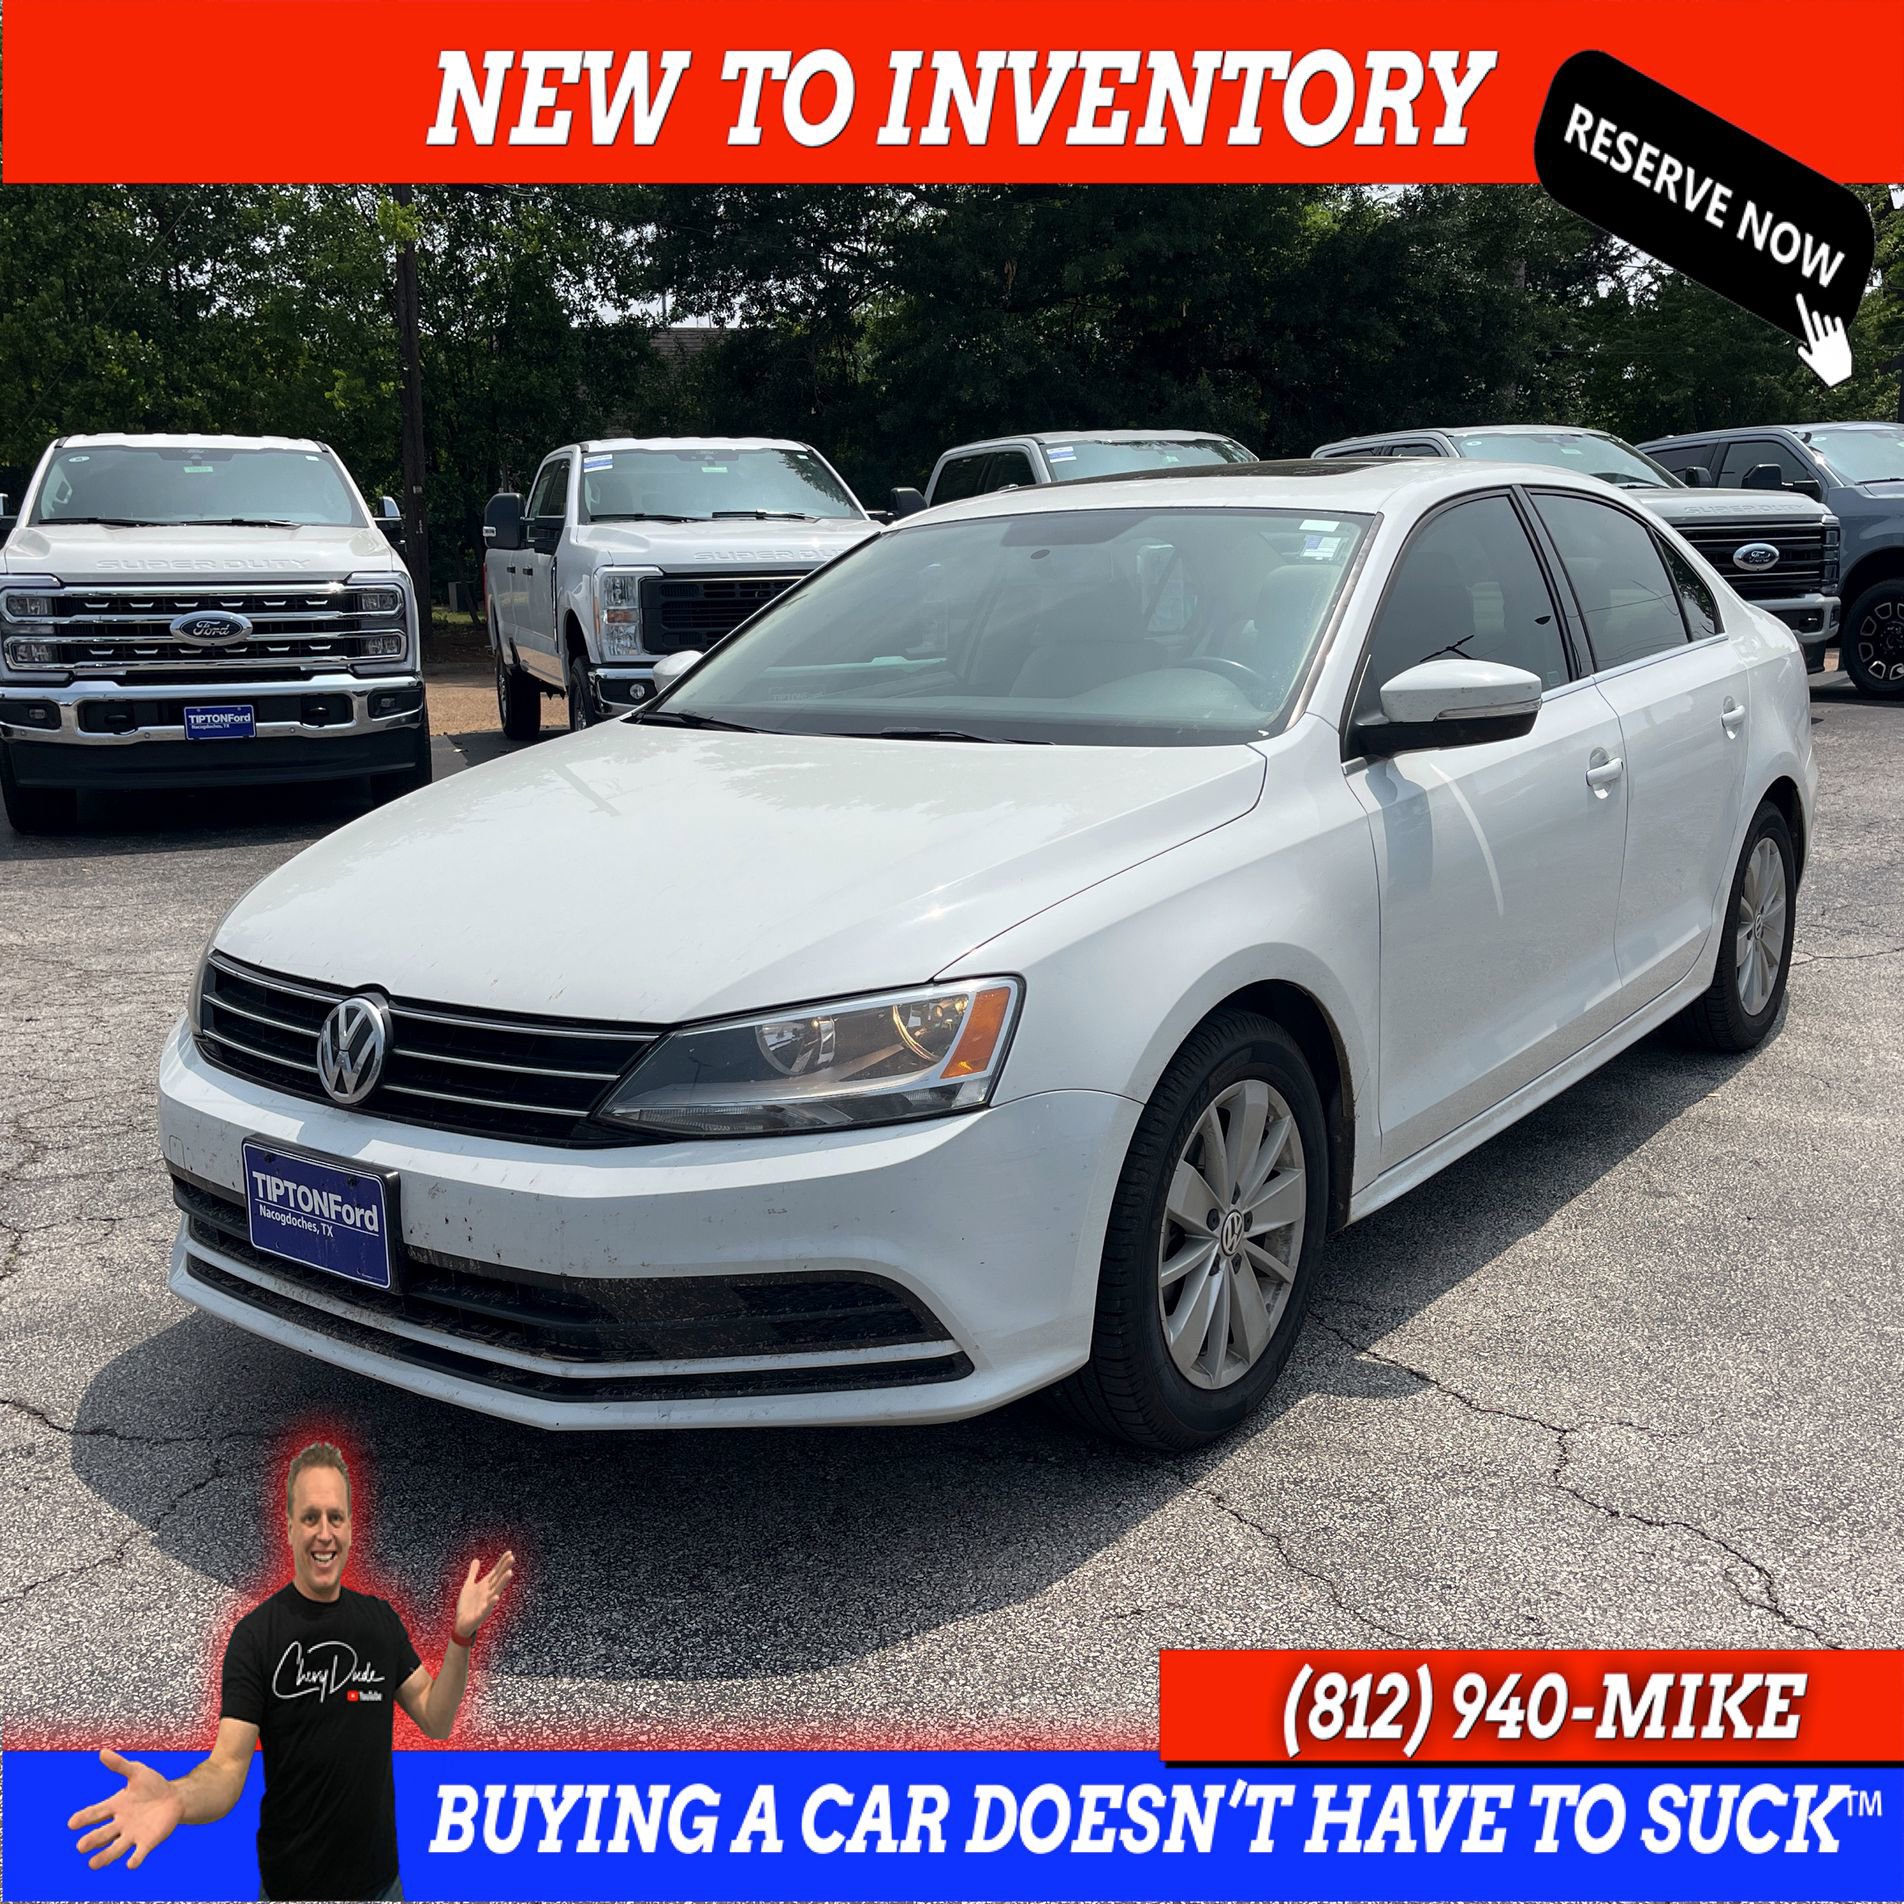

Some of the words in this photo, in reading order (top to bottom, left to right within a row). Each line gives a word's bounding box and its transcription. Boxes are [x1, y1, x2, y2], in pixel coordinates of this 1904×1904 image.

[695, 551, 794, 561] SUPER
[1748, 550, 1771, 562] Ford
[95, 559, 217, 570] SUPER
[223, 559, 311, 569] DUTY
[192, 620, 230, 636] Ford
[253, 1171, 379, 1232] TIPTONFord
[259, 1204, 320, 1235] Nacogdoches,
[321, 1223, 334, 1238] TX
